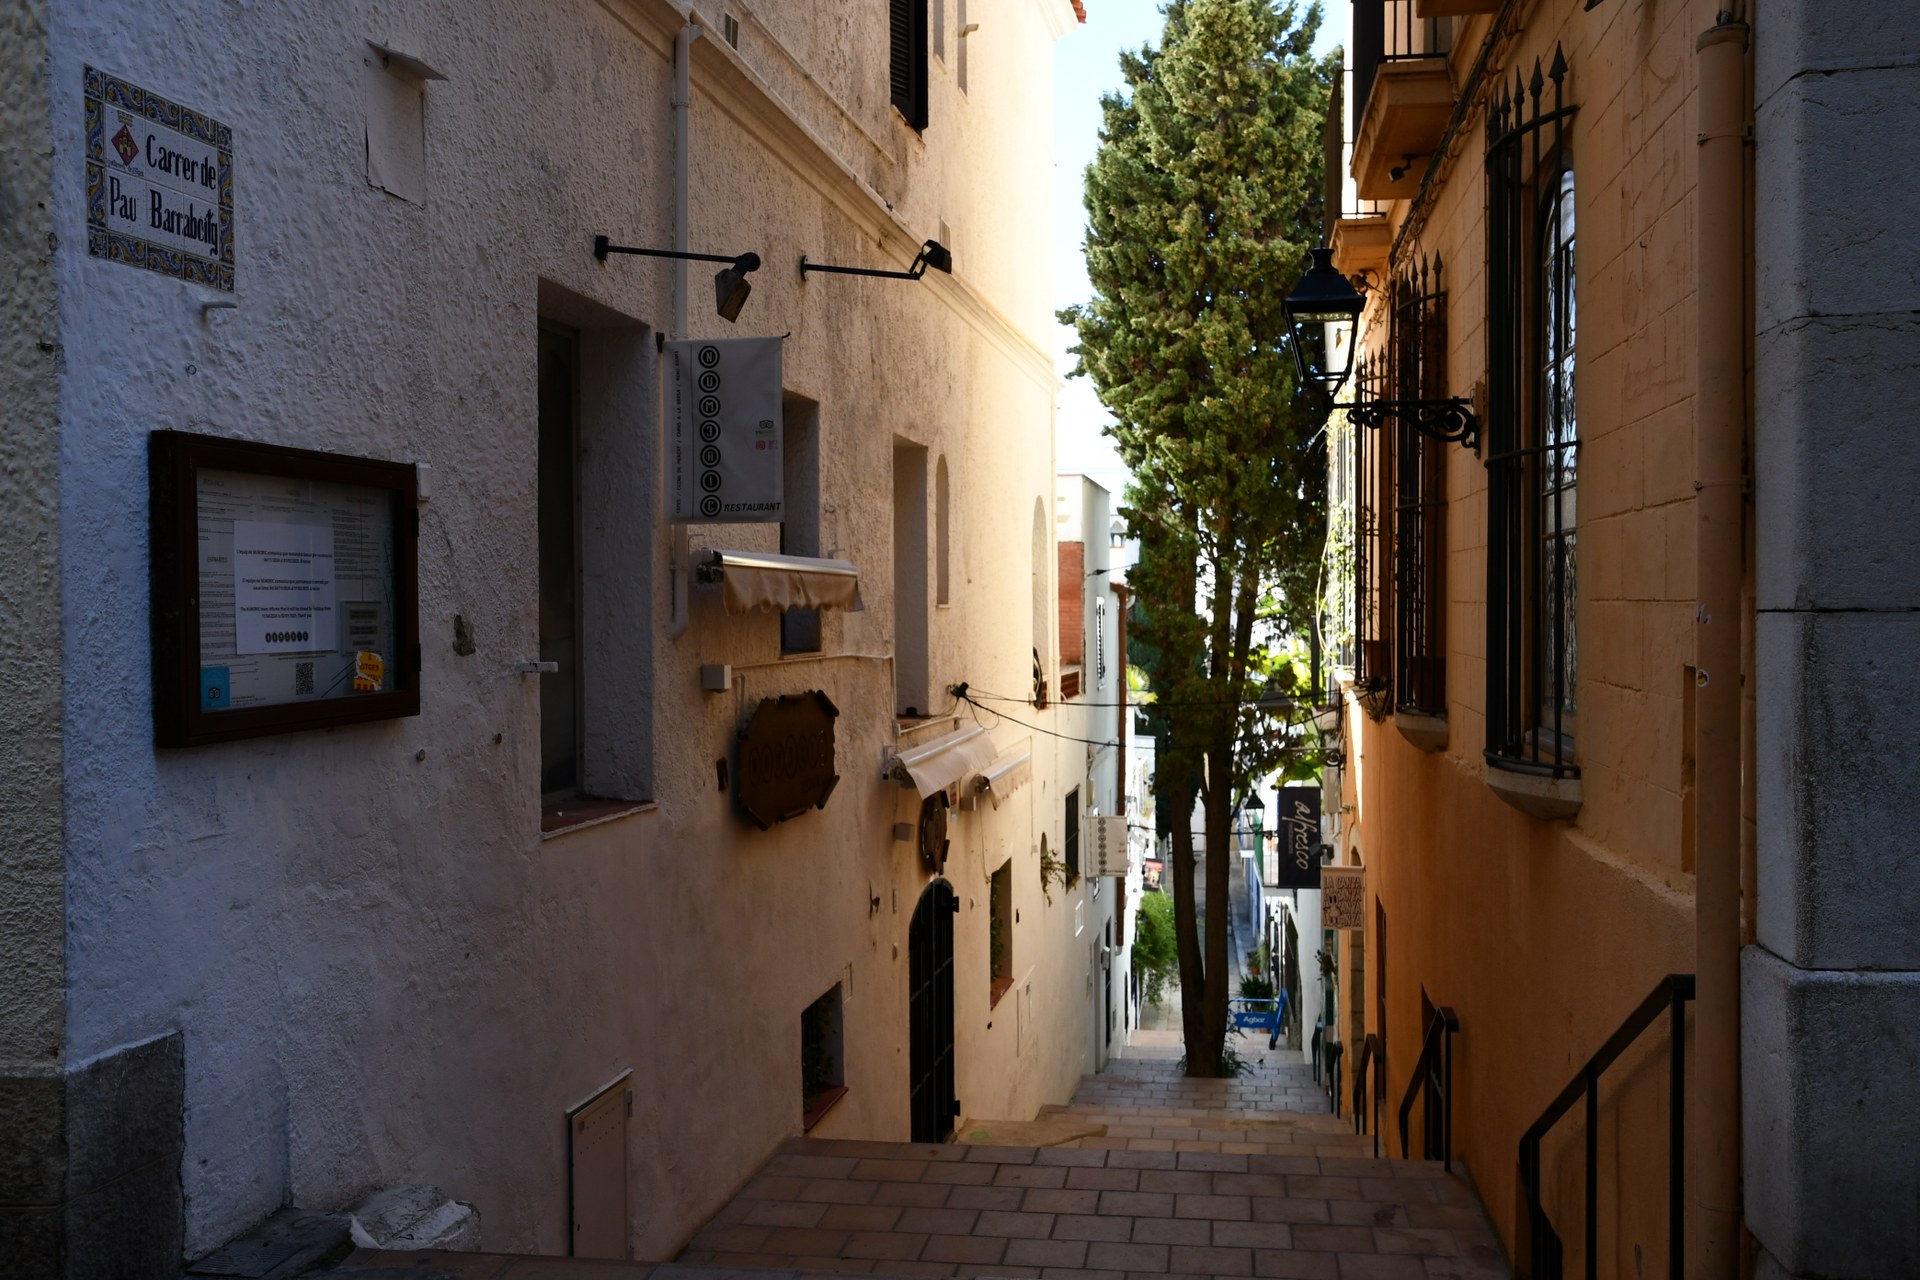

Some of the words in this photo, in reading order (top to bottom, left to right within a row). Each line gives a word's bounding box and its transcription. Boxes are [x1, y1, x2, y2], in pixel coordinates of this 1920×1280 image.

[146, 134, 198, 183] Carrer
[201, 157, 216, 190] de
[109, 175, 136, 221] Pau
[724, 502, 782, 512] RESTAURANT
[1281, 799, 1318, 870] alfresco
[1324, 876, 1334, 889] LA
[1336, 876, 1362, 890] CANYA
[1242, 1015, 1266, 1025] Agbar
